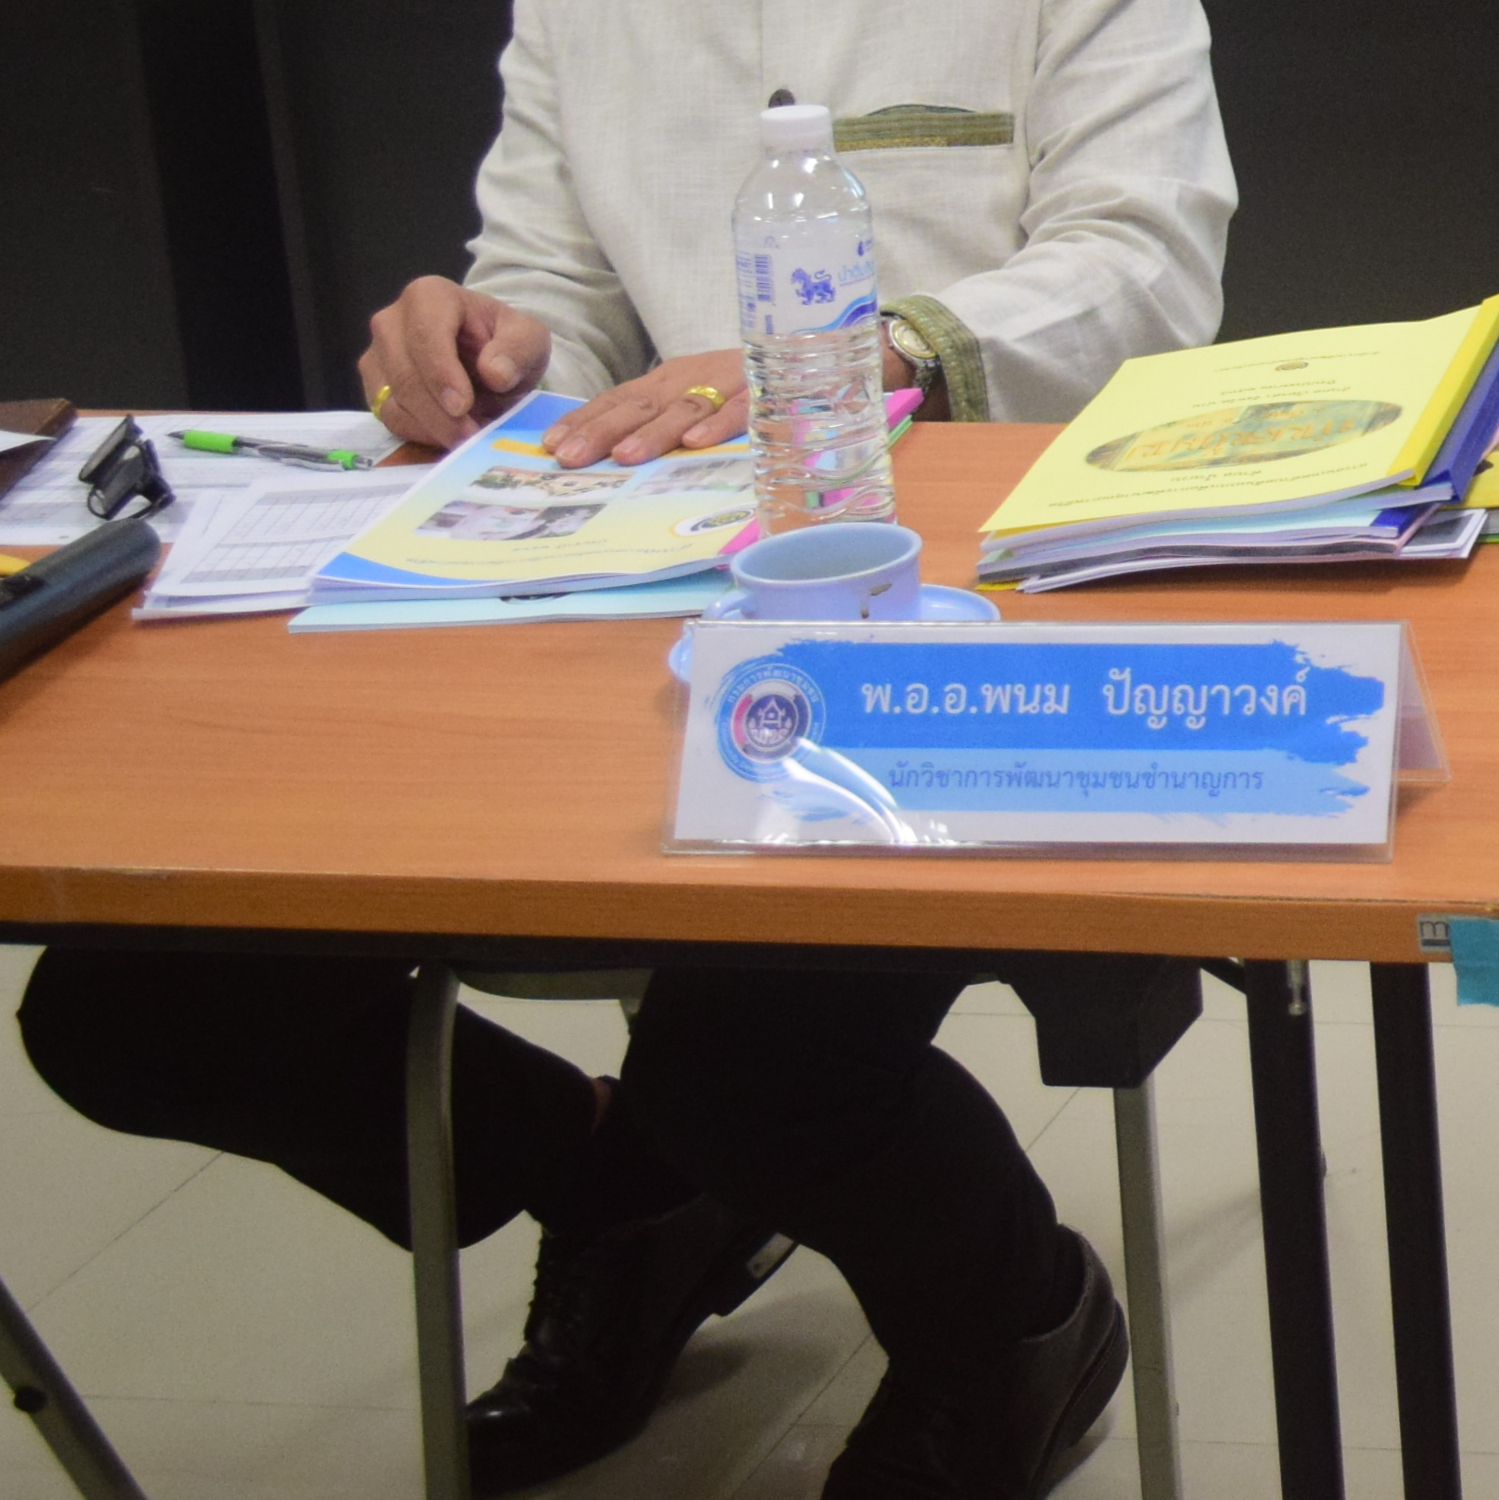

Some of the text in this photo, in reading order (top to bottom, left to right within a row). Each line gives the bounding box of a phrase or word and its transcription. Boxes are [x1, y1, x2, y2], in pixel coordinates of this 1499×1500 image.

[860, 666, 1309, 731] พ.อ.อ.พนม ปัญญาวงค์
[888, 759, 1265, 799] นักวิชาการพัฒนาชุมชนชำนาญการ
